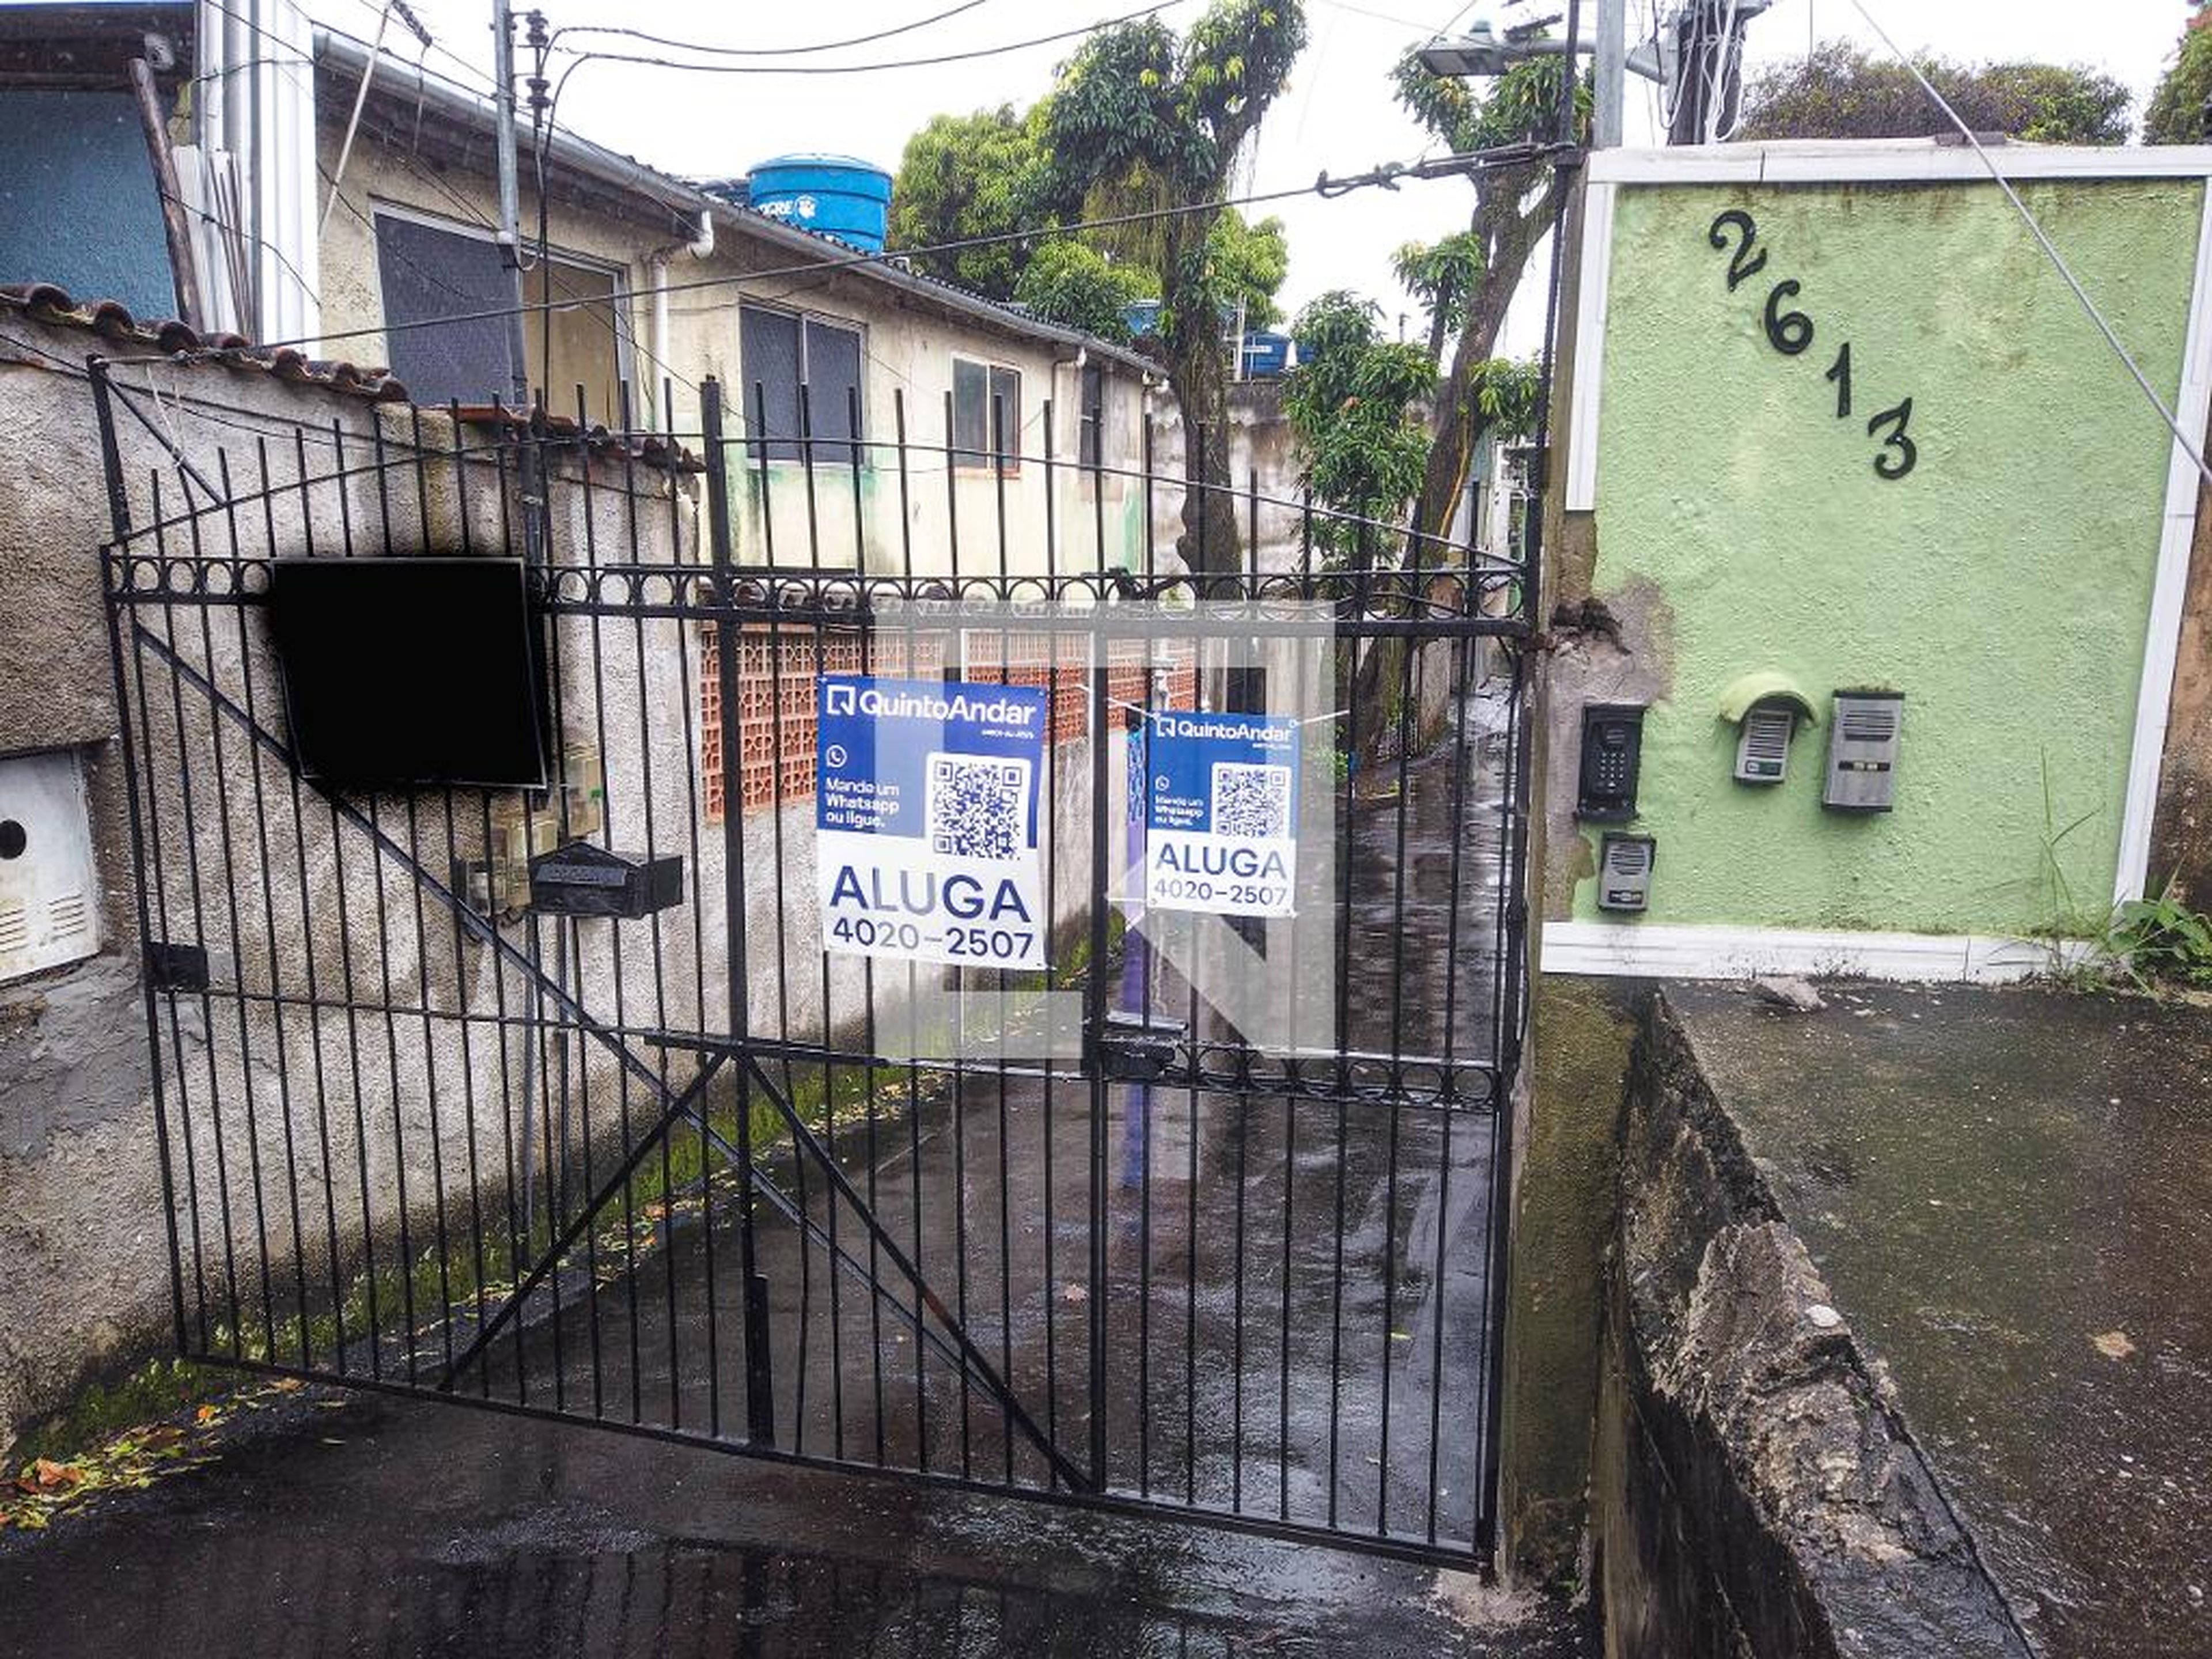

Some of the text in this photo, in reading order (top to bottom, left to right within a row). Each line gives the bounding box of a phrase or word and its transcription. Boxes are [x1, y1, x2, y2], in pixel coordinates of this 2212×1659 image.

[1709, 210, 1916, 480] 2613
[859, 690, 1036, 725] QuintoAndar
[1178, 720, 1291, 743] QuintoAndar
[826, 777, 900, 796] Mande um
[826, 811, 844, 824] ou
[1156, 843, 1286, 879] ALUGA
[830, 865, 1031, 922] ALUGA
[1154, 879, 1287, 906] 4020-2507
[833, 917, 1033, 959] 4020-2507
